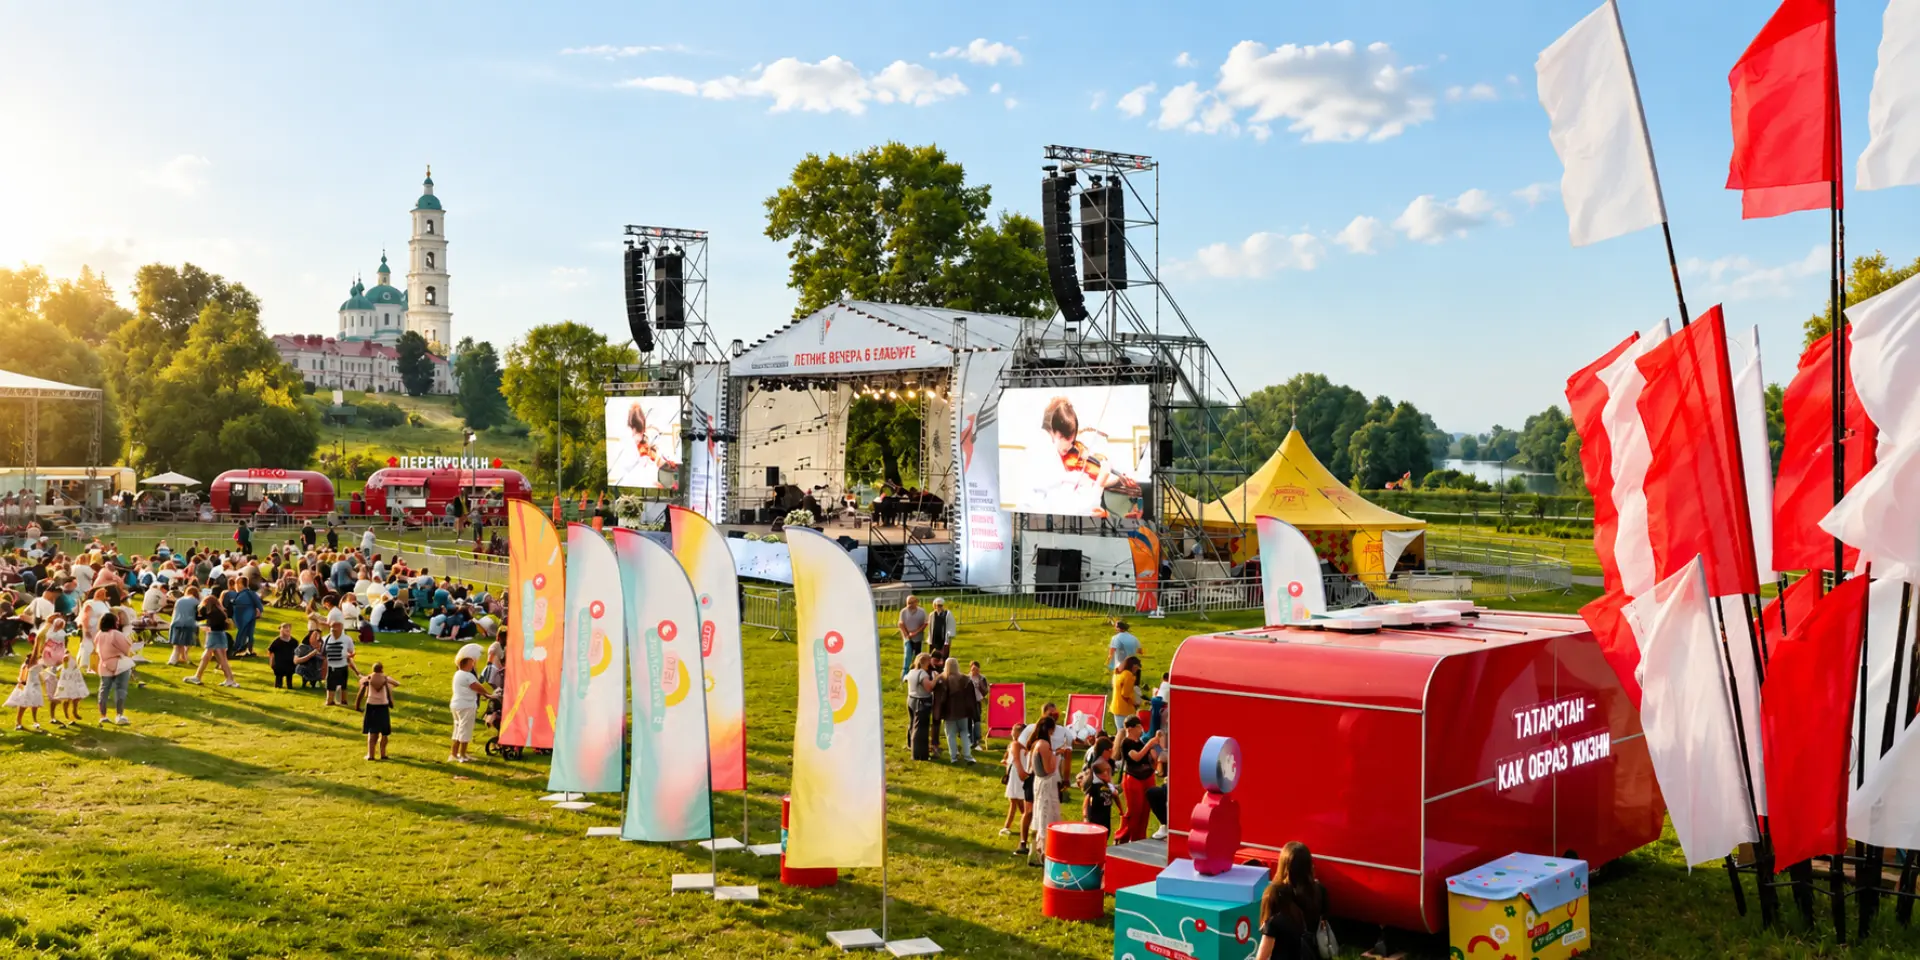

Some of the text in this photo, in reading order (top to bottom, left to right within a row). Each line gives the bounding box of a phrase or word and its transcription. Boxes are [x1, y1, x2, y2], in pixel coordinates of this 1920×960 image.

[793, 351, 826, 367] ЛЕТНИЕ
[828, 347, 862, 364] ВЕЧЕРА
[1514, 697, 1584, 739] ТАТАРСТАН
[1498, 732, 1610, 791] КАК ОБРАЗ ЖИЗНИ
